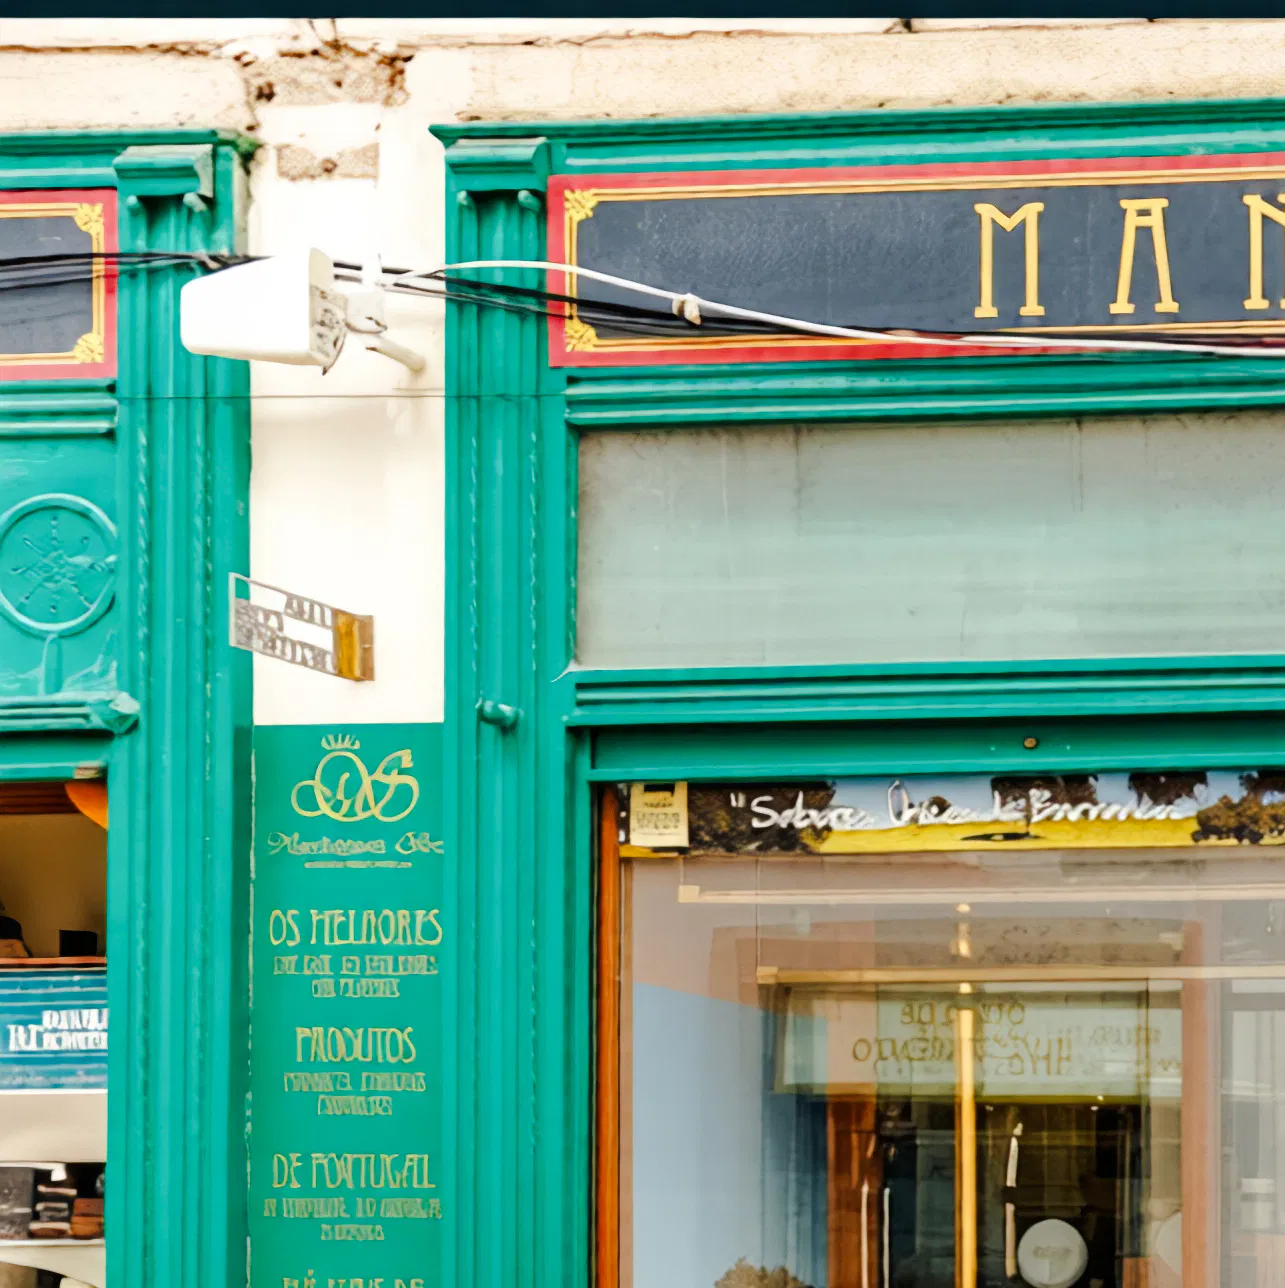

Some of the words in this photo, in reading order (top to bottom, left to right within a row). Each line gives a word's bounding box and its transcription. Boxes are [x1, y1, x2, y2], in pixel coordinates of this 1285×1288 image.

[269, 908, 301, 947] OS
[310, 908, 443, 946] MELHORES
[295, 1025, 417, 1064] PRODUTOS
[271, 1152, 304, 1189] DE
[311, 1152, 437, 1190] PORTUGAL
